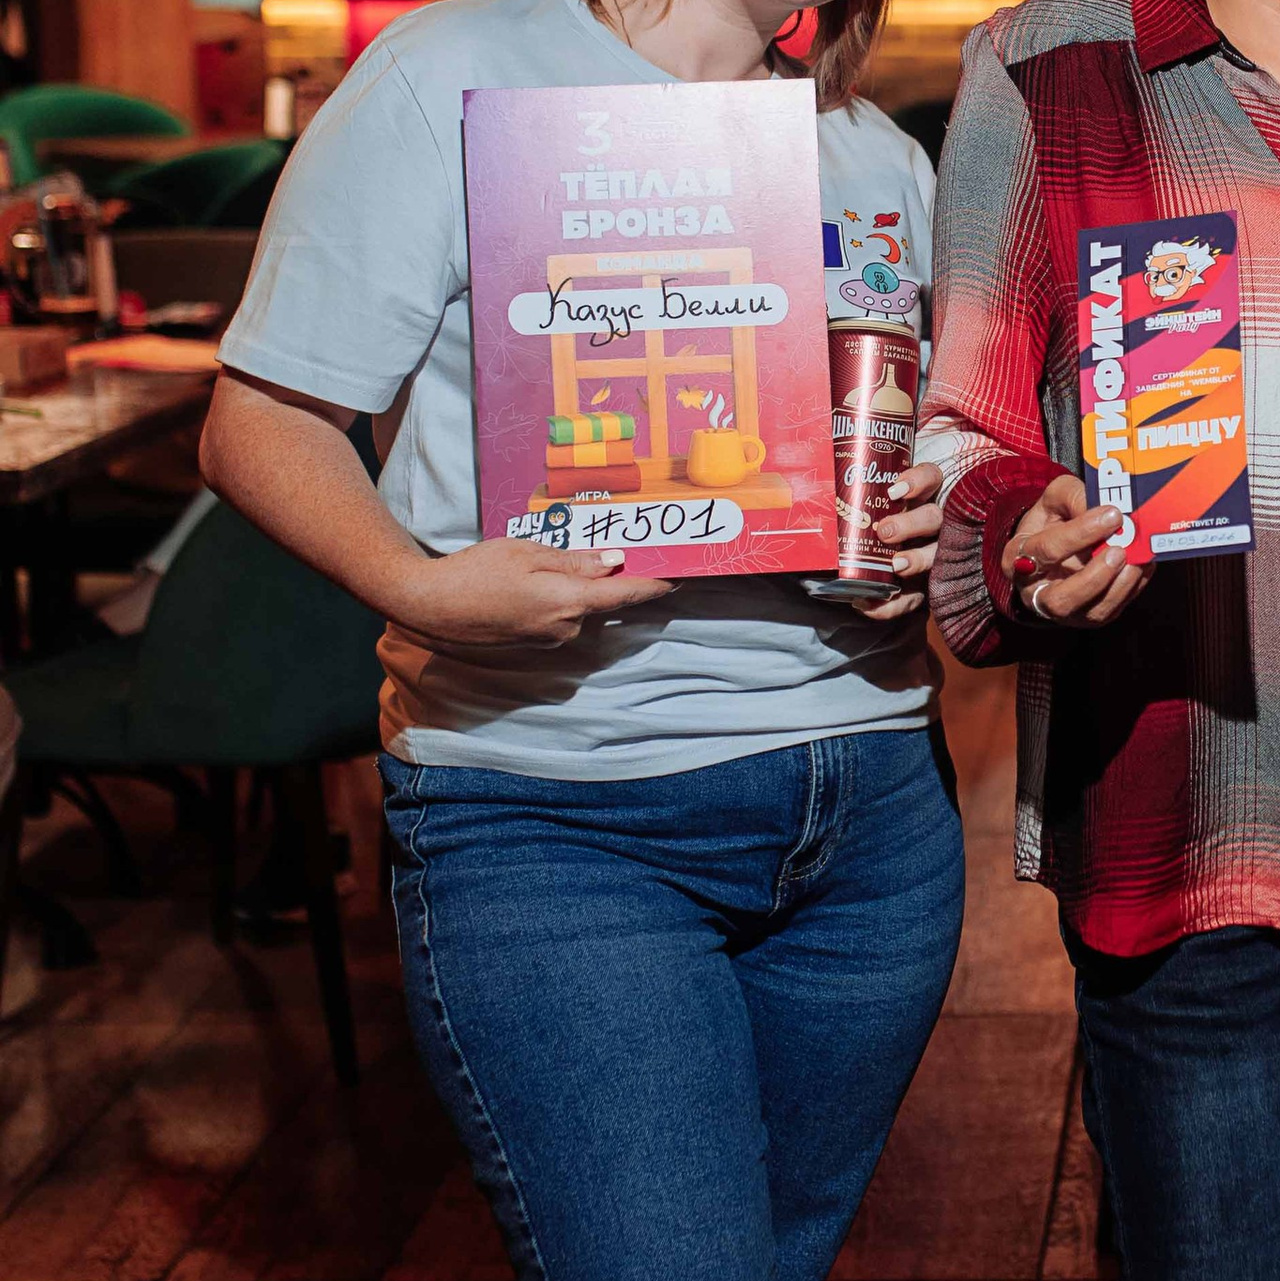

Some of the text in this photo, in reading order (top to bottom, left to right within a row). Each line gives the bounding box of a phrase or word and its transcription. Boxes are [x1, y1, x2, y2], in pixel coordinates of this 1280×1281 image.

[577, 111, 612, 156] 3
[559, 163, 733, 202] ТЁПЛАЯ
[562, 205, 735, 240] БРОНЗА
[539, 277, 772, 347] Казус Белли
[1168, 321, 1201, 334] Party
[1209, 366, 1220, 375] ОТ
[1090, 241, 1136, 548] СЕРТИФИКАТ
[1138, 415, 1242, 451] ПИЦЦУ
[875, 442, 891, 451] 1976
[844, 461, 902, 486] Pilsne
[575, 490, 611, 502] ИГРА
[864, 495, 890, 509] 4,0%
[507, 512, 547, 538] ВАУ
[583, 498, 726, 547] #501
[1170, 518, 1215, 531] ДЕЙСТВУЕТ
[526, 528, 566, 548] ВИЗ
[873, 547, 898, 556] КАЧЕСТ
